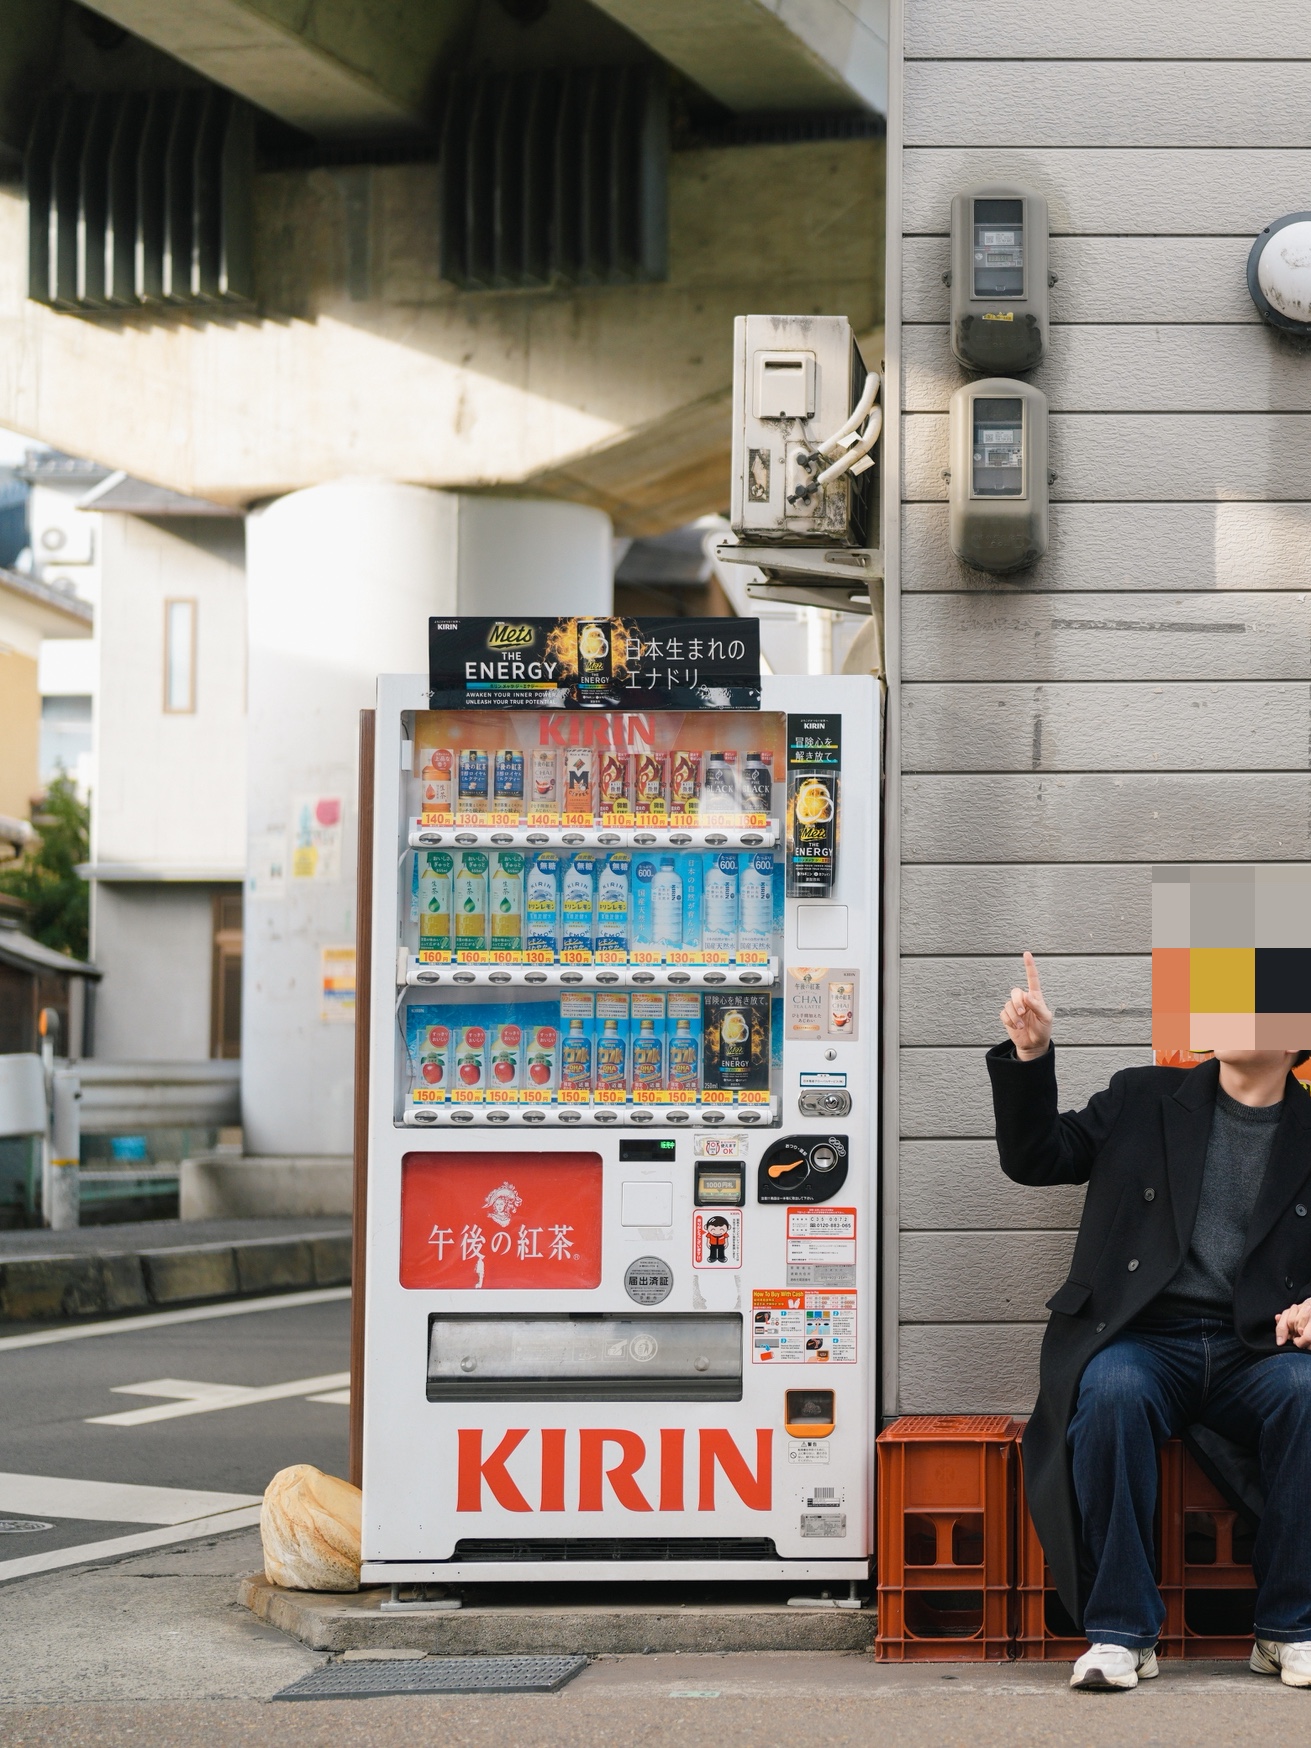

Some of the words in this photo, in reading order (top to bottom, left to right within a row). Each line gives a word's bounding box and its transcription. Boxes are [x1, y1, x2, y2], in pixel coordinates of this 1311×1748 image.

[489, 625, 532, 643] Mets
[625, 637, 745, 661] 日本生まれの
[501, 652, 522, 661] THE
[465, 662, 557, 680] ENERGY
[581, 676, 610, 684] ENERGY
[625, 668, 707, 690] エナドリ。
[540, 716, 656, 746] KIRIN
[803, 722, 826, 730] KIRIN
[795, 736, 833, 748] 冒険心を
[425, 814, 450, 824] 140円
[460, 814, 485, 824] 130円
[491, 814, 517, 824] 130円
[532, 814, 557, 824] 140円
[566, 814, 591, 824] 140円
[606, 814, 631, 825] 110円
[640, 814, 666, 825] 110円
[795, 848, 833, 856] ENERGY
[540, 862, 556, 870] 無糖
[577, 862, 593, 870] 無糖
[612, 862, 628, 870] 無糖
[531, 881, 552, 889] KIRIN
[567, 881, 588, 889] KIRIN
[603, 881, 624, 889] KIRIN
[705, 942, 736, 950] 国産天然水
[740, 942, 771, 950] 国産天然水
[424, 952, 448, 962] 160円
[462, 952, 486, 962] 160円
[495, 952, 519, 962] 160円
[527, 952, 552, 963] 130円
[564, 952, 589, 963] 130円
[599, 952, 624, 963] 130円
[634, 952, 659, 963] 130円
[670, 952, 695, 963] 130円
[701, 952, 726, 963] 130円
[740, 952, 765, 963] 130円
[704, 995, 769, 1006] 冒険心を解き放て。
[792, 995, 822, 1004] CHAI
[417, 1091, 442, 1102] 150円
[455, 1091, 480, 1102] 150円
[490, 1091, 515, 1102] 150円
[523, 1091, 548, 1102] 150円
[562, 1091, 587, 1102] 150円
[598, 1091, 623, 1102] 150円
[637, 1091, 662, 1102] 150円
[669, 1091, 694, 1102] 150円
[704, 1091, 730, 1102] 200円
[741, 1091, 767, 1102] 200円
[428, 1224, 575, 1261] 午後の紅茶
[628, 1275, 669, 1286] 届出済証
[456, 1428, 774, 1513] KIRIN
